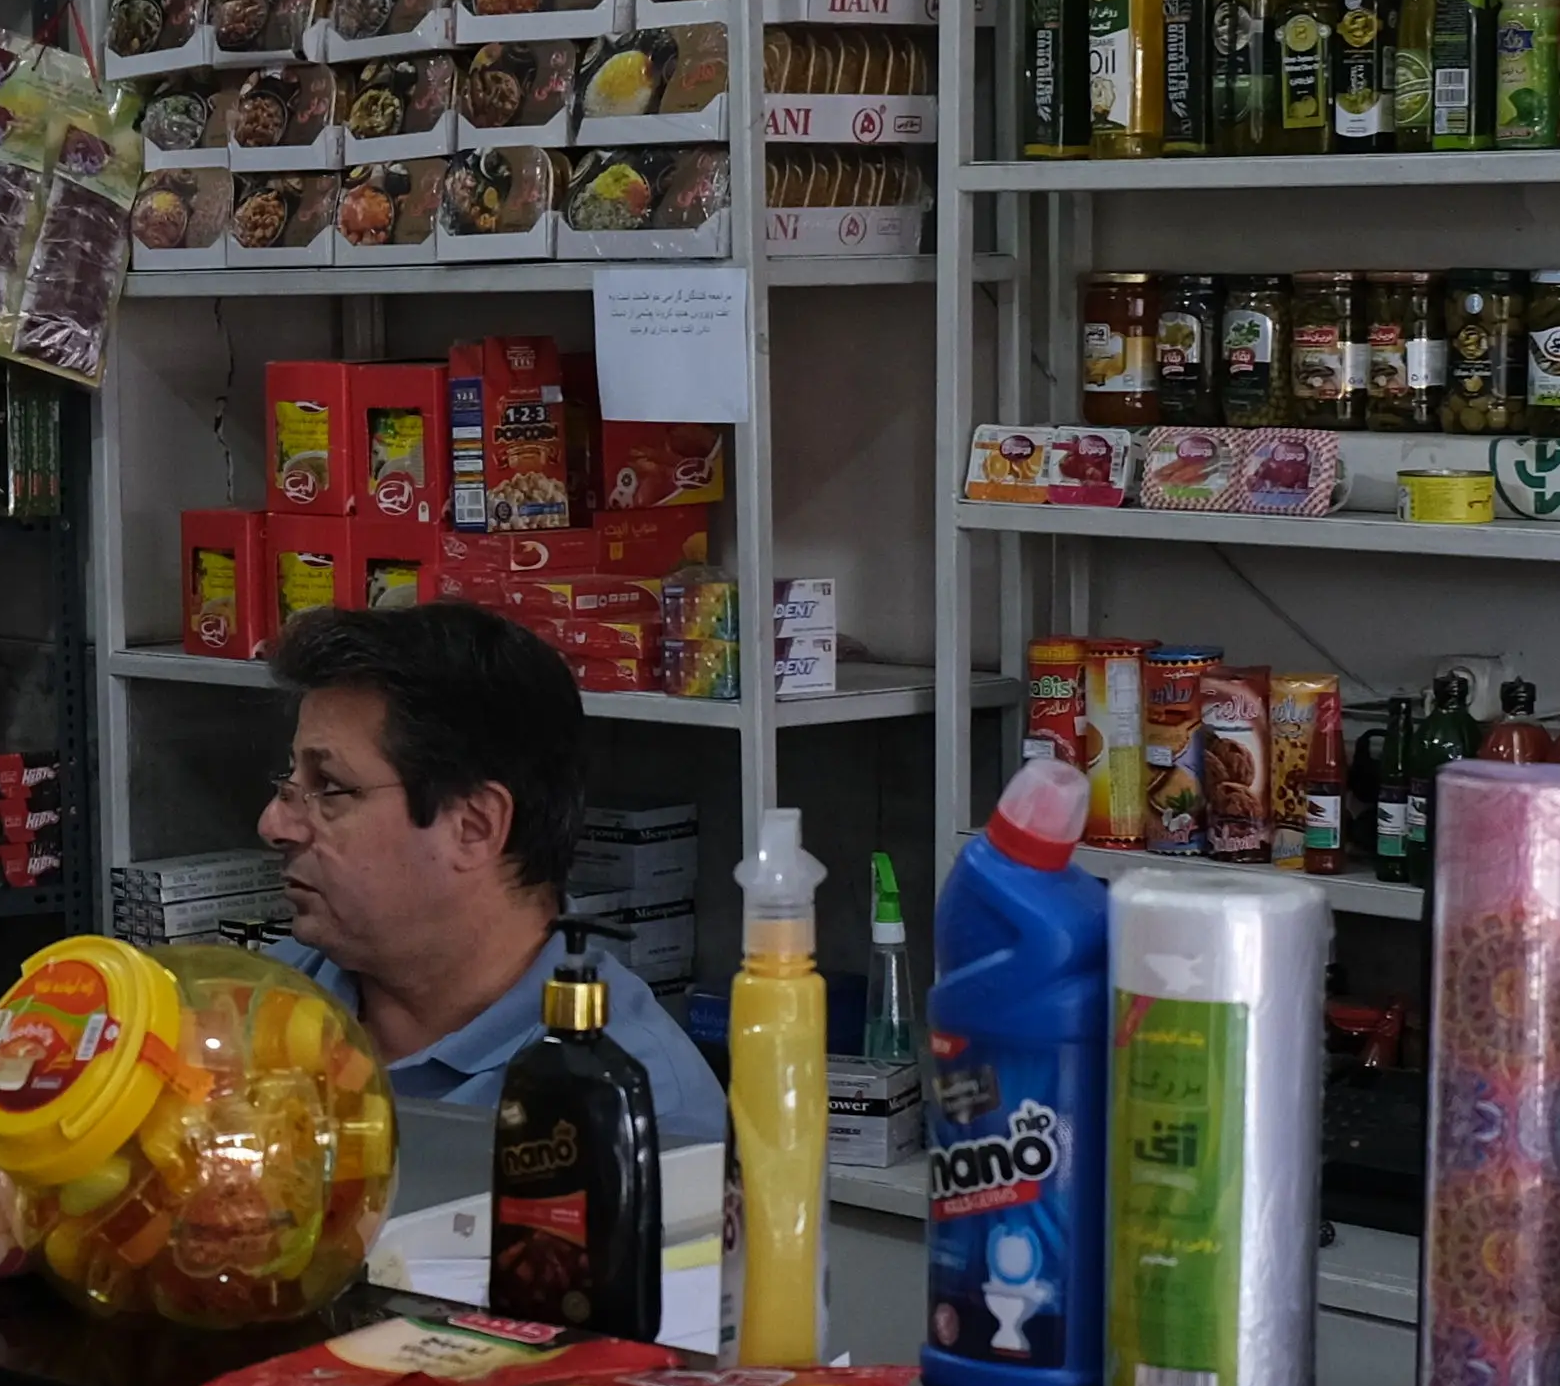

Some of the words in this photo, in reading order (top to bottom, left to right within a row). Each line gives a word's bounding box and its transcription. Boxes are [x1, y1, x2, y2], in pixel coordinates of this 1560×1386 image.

[764, 108, 812, 136] ANI
[493, 426, 558, 441] POPCORN
[504, 1139, 575, 1173] nano
[930, 1136, 1053, 1195] nano
